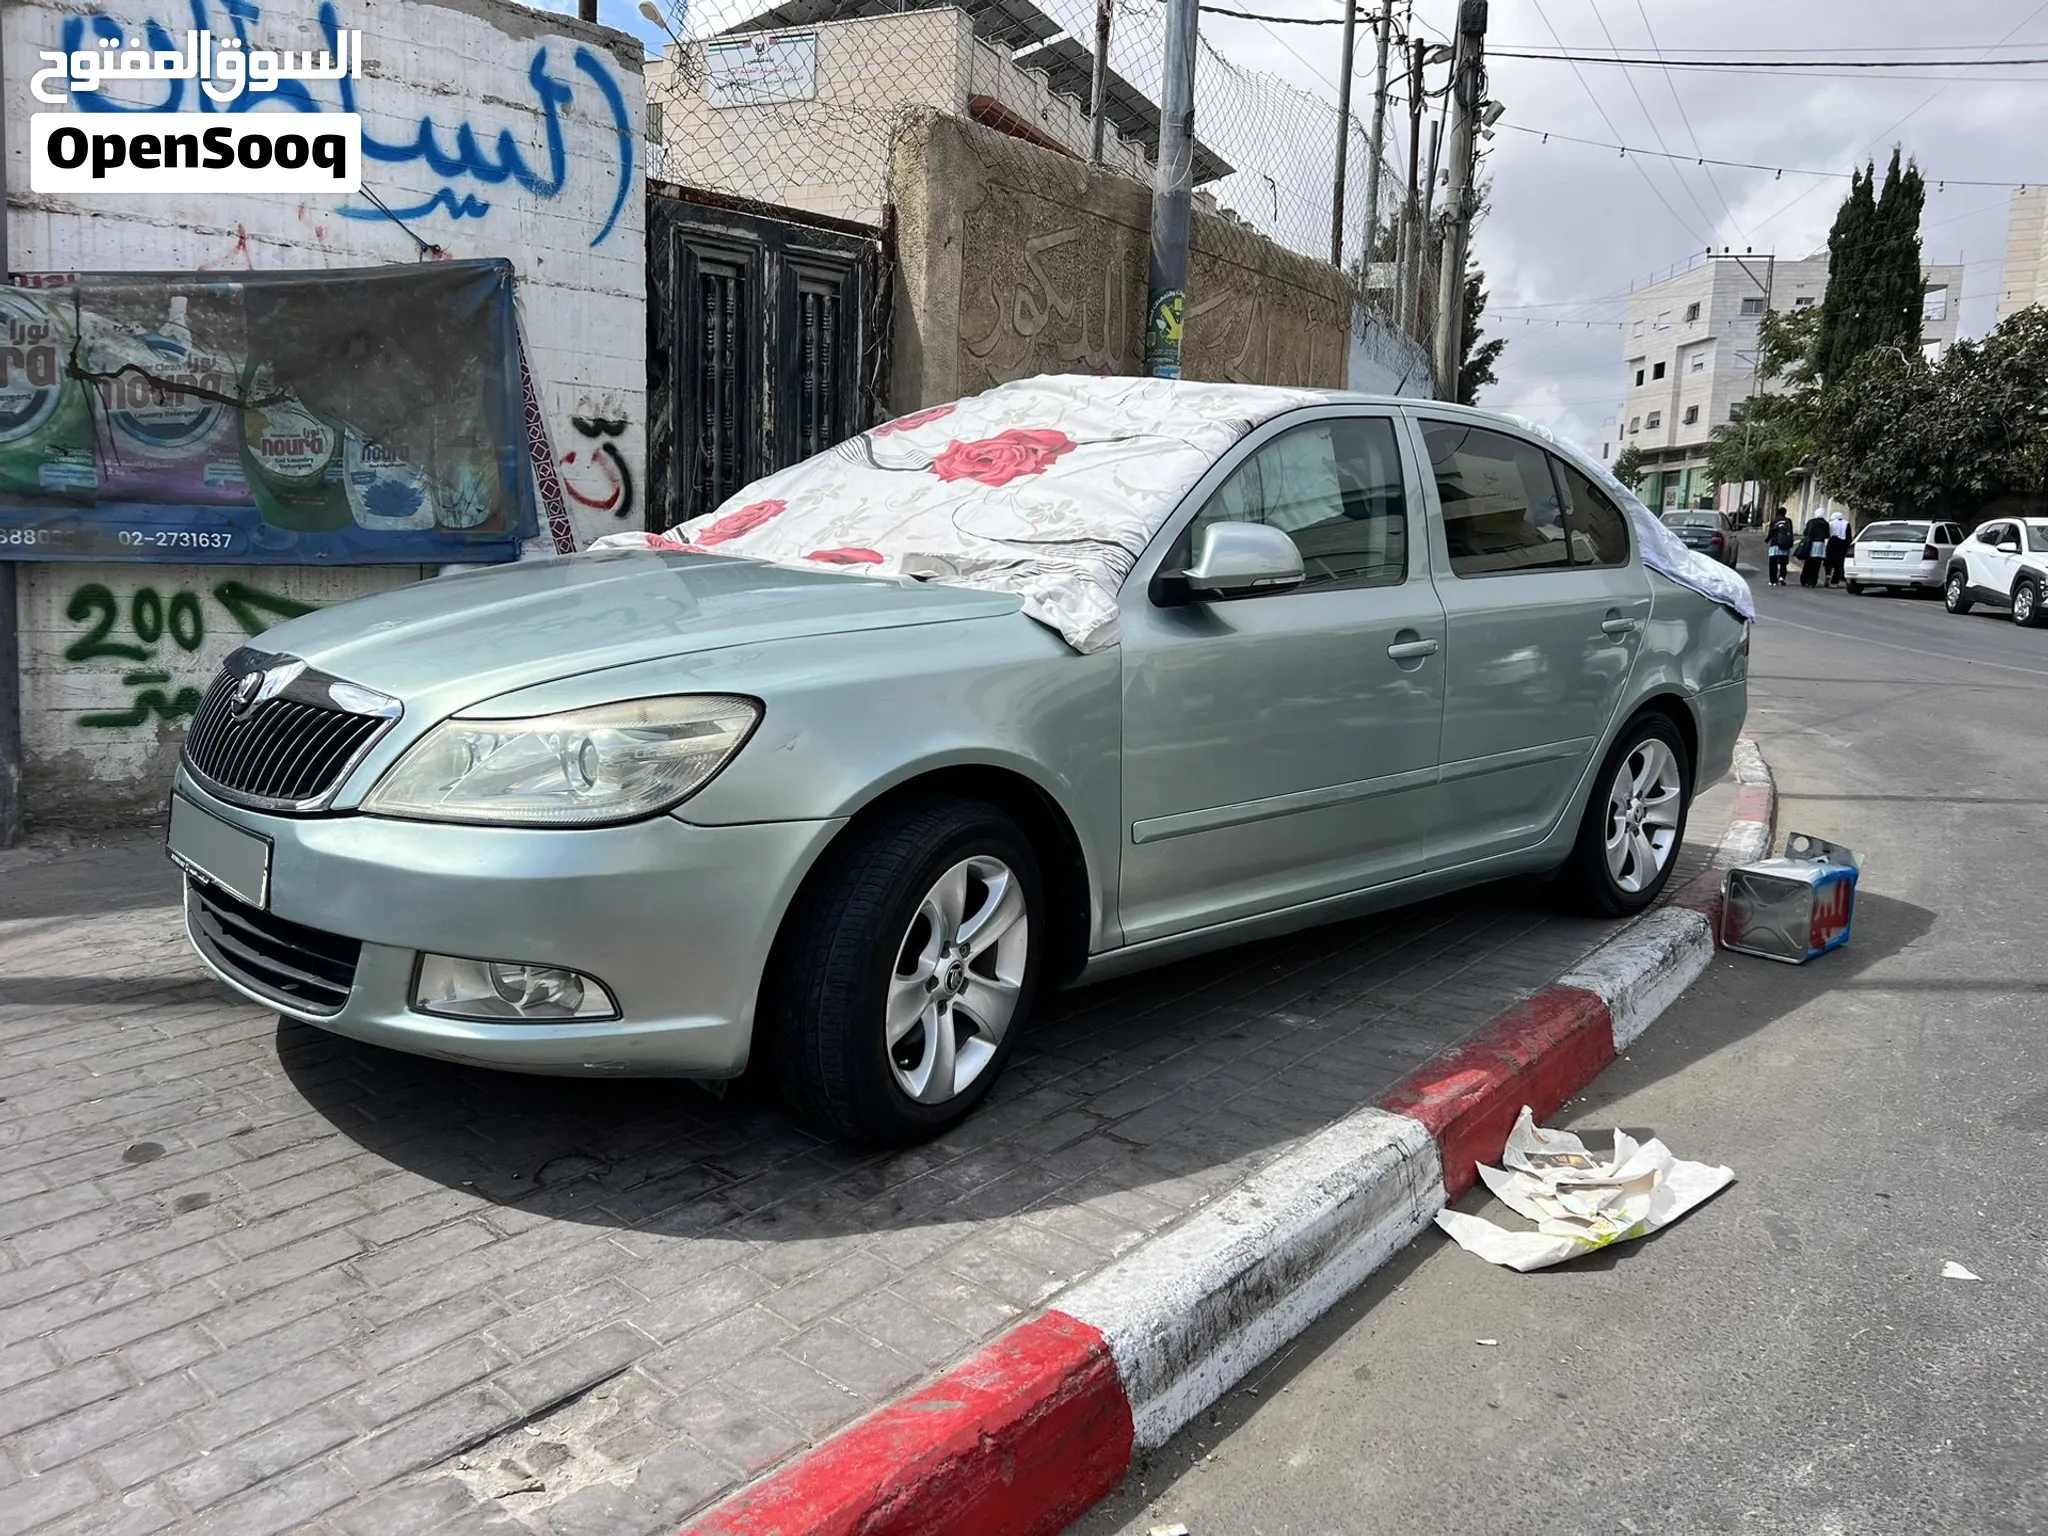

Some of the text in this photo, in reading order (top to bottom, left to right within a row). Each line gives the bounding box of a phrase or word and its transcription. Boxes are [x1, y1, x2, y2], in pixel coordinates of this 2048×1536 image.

[10, 318, 50, 346] نورا
[187, 351, 217, 374] نورا
[262, 438, 323, 457] noura
[118, 531, 232, 548] 02-2731637
[65, 583, 204, 661] 200
